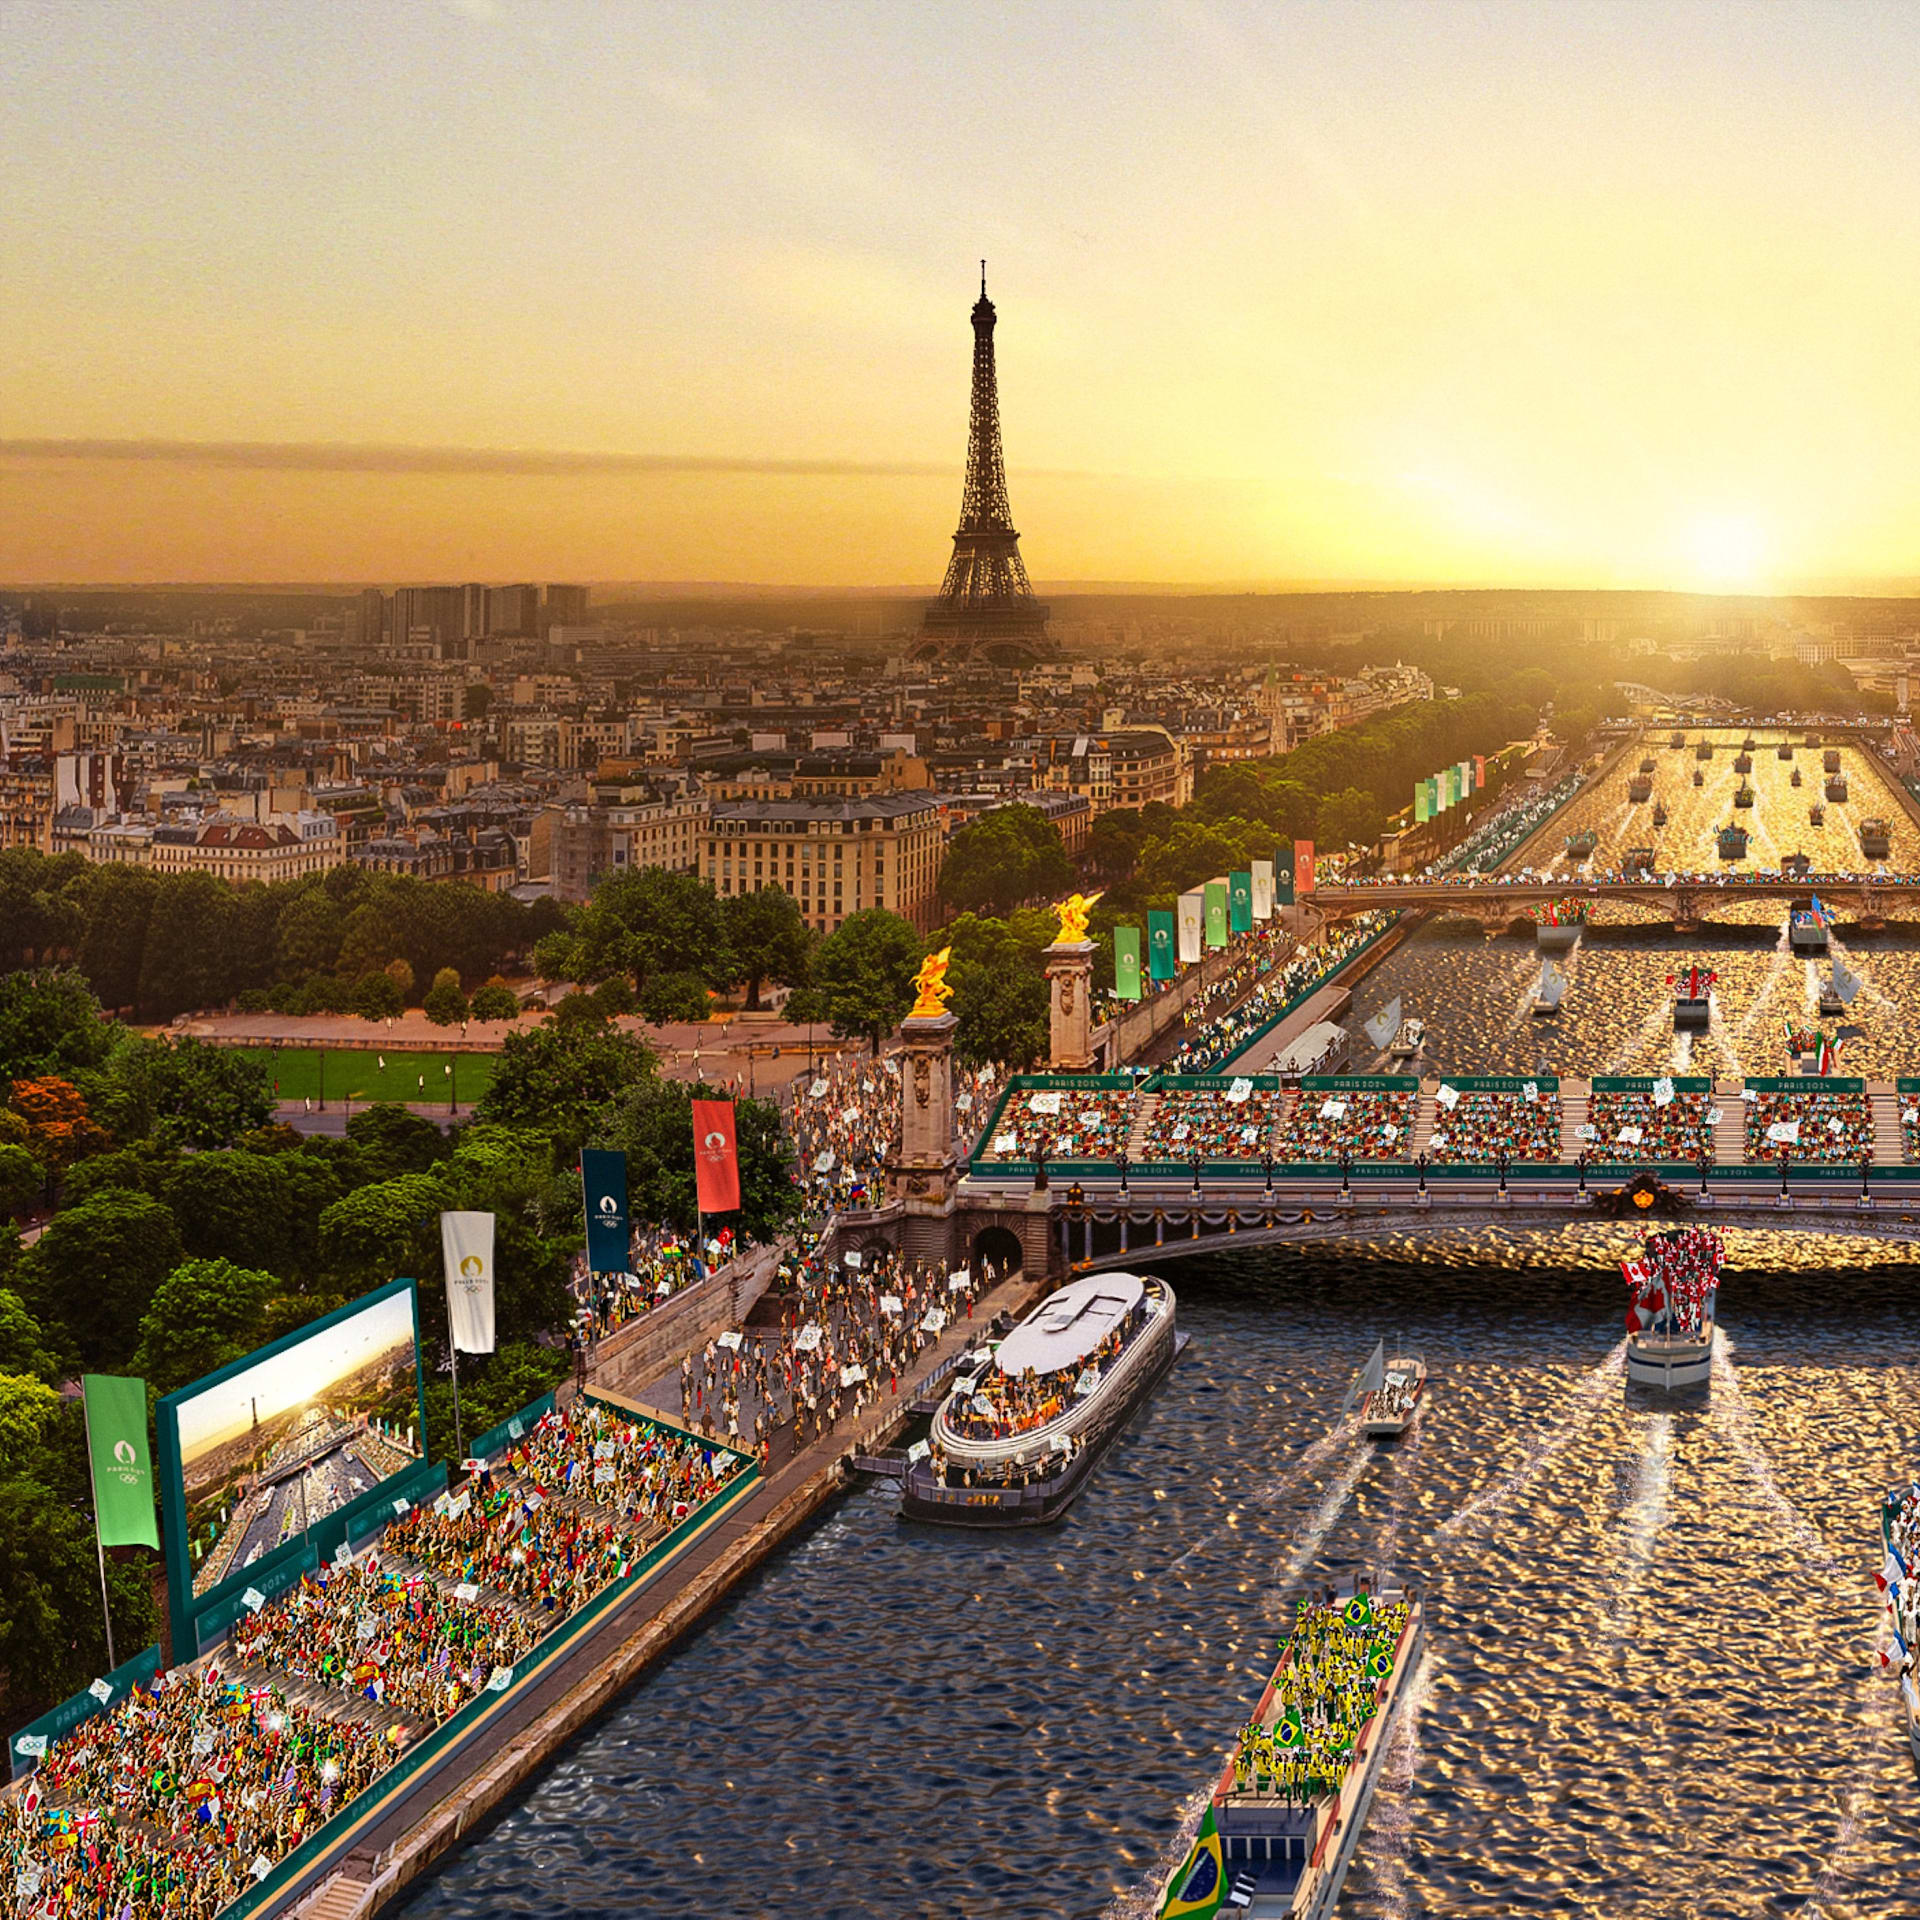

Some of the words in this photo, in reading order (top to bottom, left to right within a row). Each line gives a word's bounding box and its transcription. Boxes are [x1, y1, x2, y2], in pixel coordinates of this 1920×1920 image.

[1049, 1079, 1074, 1087] PARIS
[1077, 1079, 1101, 1087] 2024
[1194, 1080, 1220, 1088] PARIS
[1334, 1080, 1360, 1088] PARIS
[1362, 1080, 1386, 1088] 2024
[1474, 1081, 1500, 1089] PARIS
[1625, 1081, 1651, 1089] PARIS
[1778, 1081, 1804, 1090] PARIS
[1807, 1082, 1830, 1090] 2024
[56, 1700, 89, 1728] PARIS
